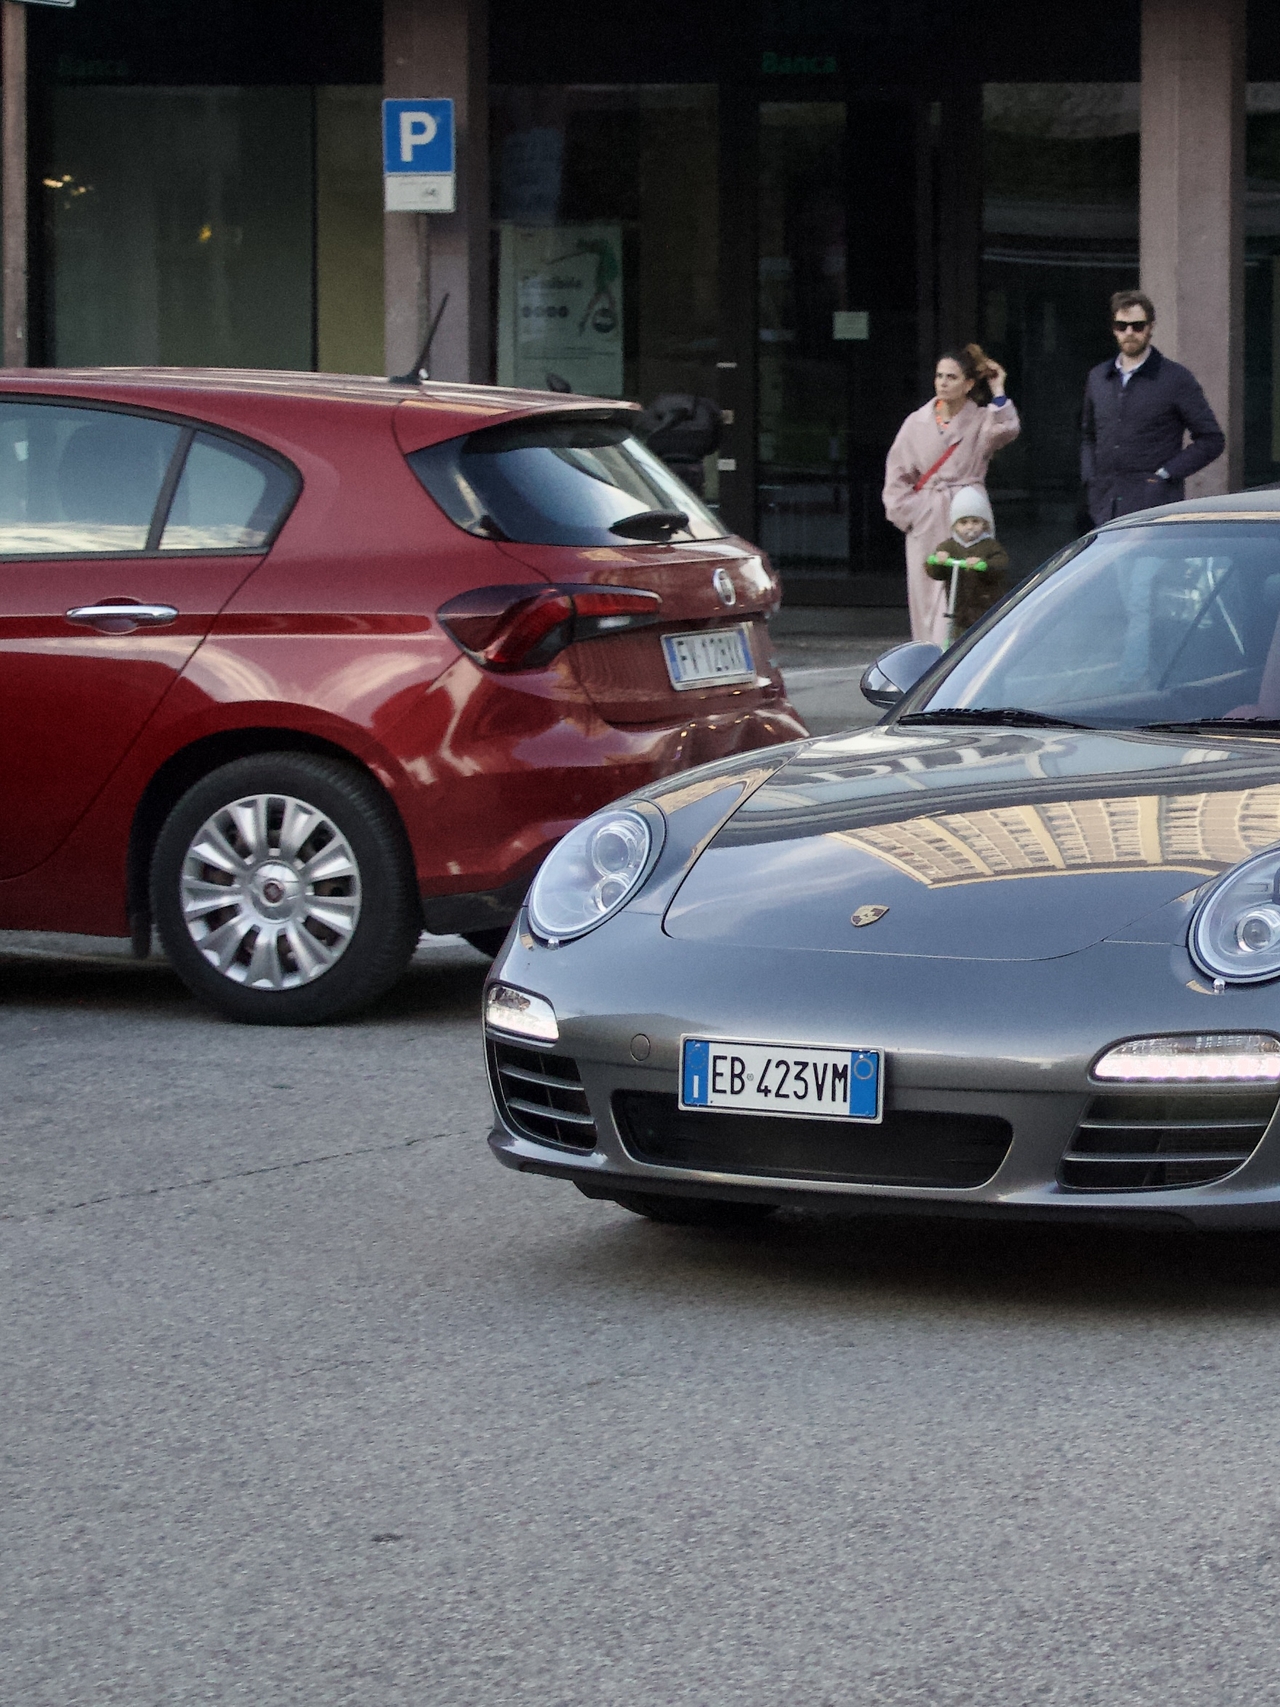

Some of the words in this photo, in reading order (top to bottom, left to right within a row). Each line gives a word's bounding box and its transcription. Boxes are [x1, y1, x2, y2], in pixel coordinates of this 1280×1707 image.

[762, 51, 837, 74] Banca
[400, 111, 438, 162] P
[712, 1055, 746, 1095] EB
[756, 1058, 849, 1103] 423VM
